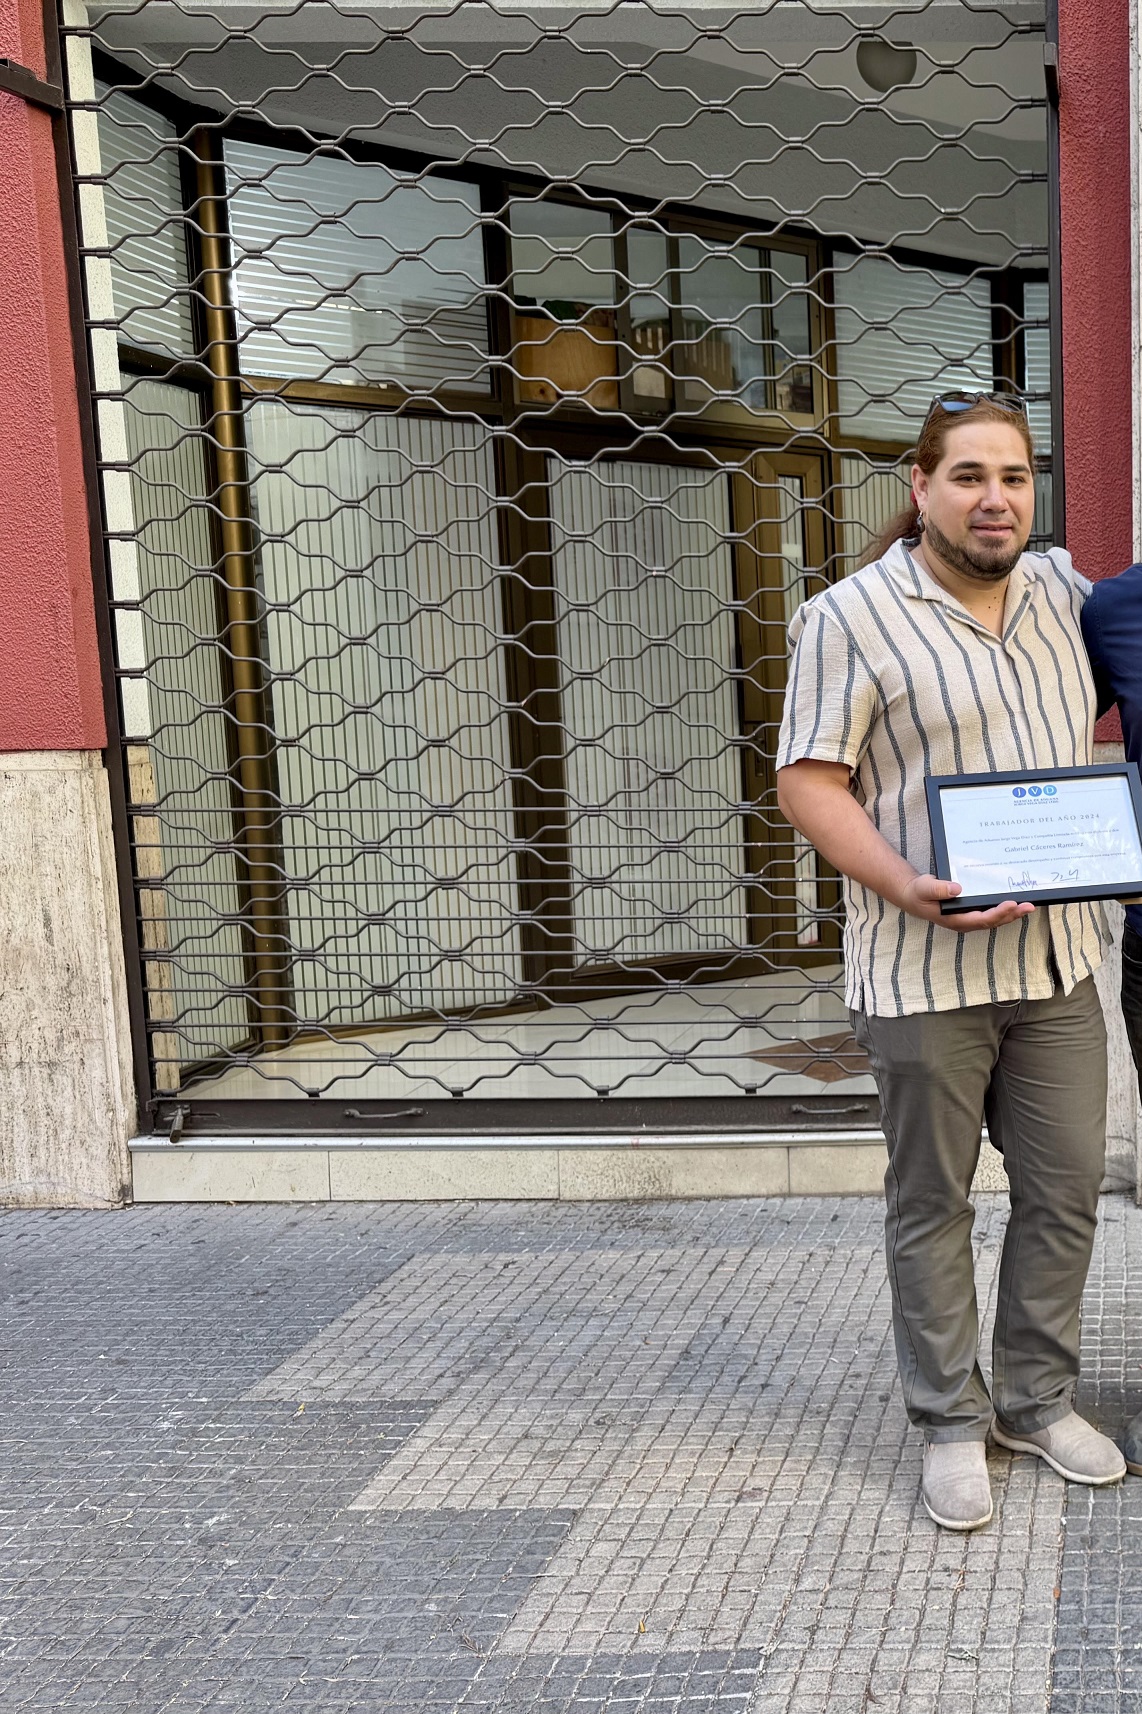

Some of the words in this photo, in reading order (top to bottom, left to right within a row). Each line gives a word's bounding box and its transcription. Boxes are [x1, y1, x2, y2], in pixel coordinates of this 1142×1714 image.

[980, 818, 1035, 827] TRABAJADOR
[1004, 845, 1029, 853] Gabriel
[1031, 843, 1056, 851] Cáceres
[1057, 841, 1084, 849] Ramírez
